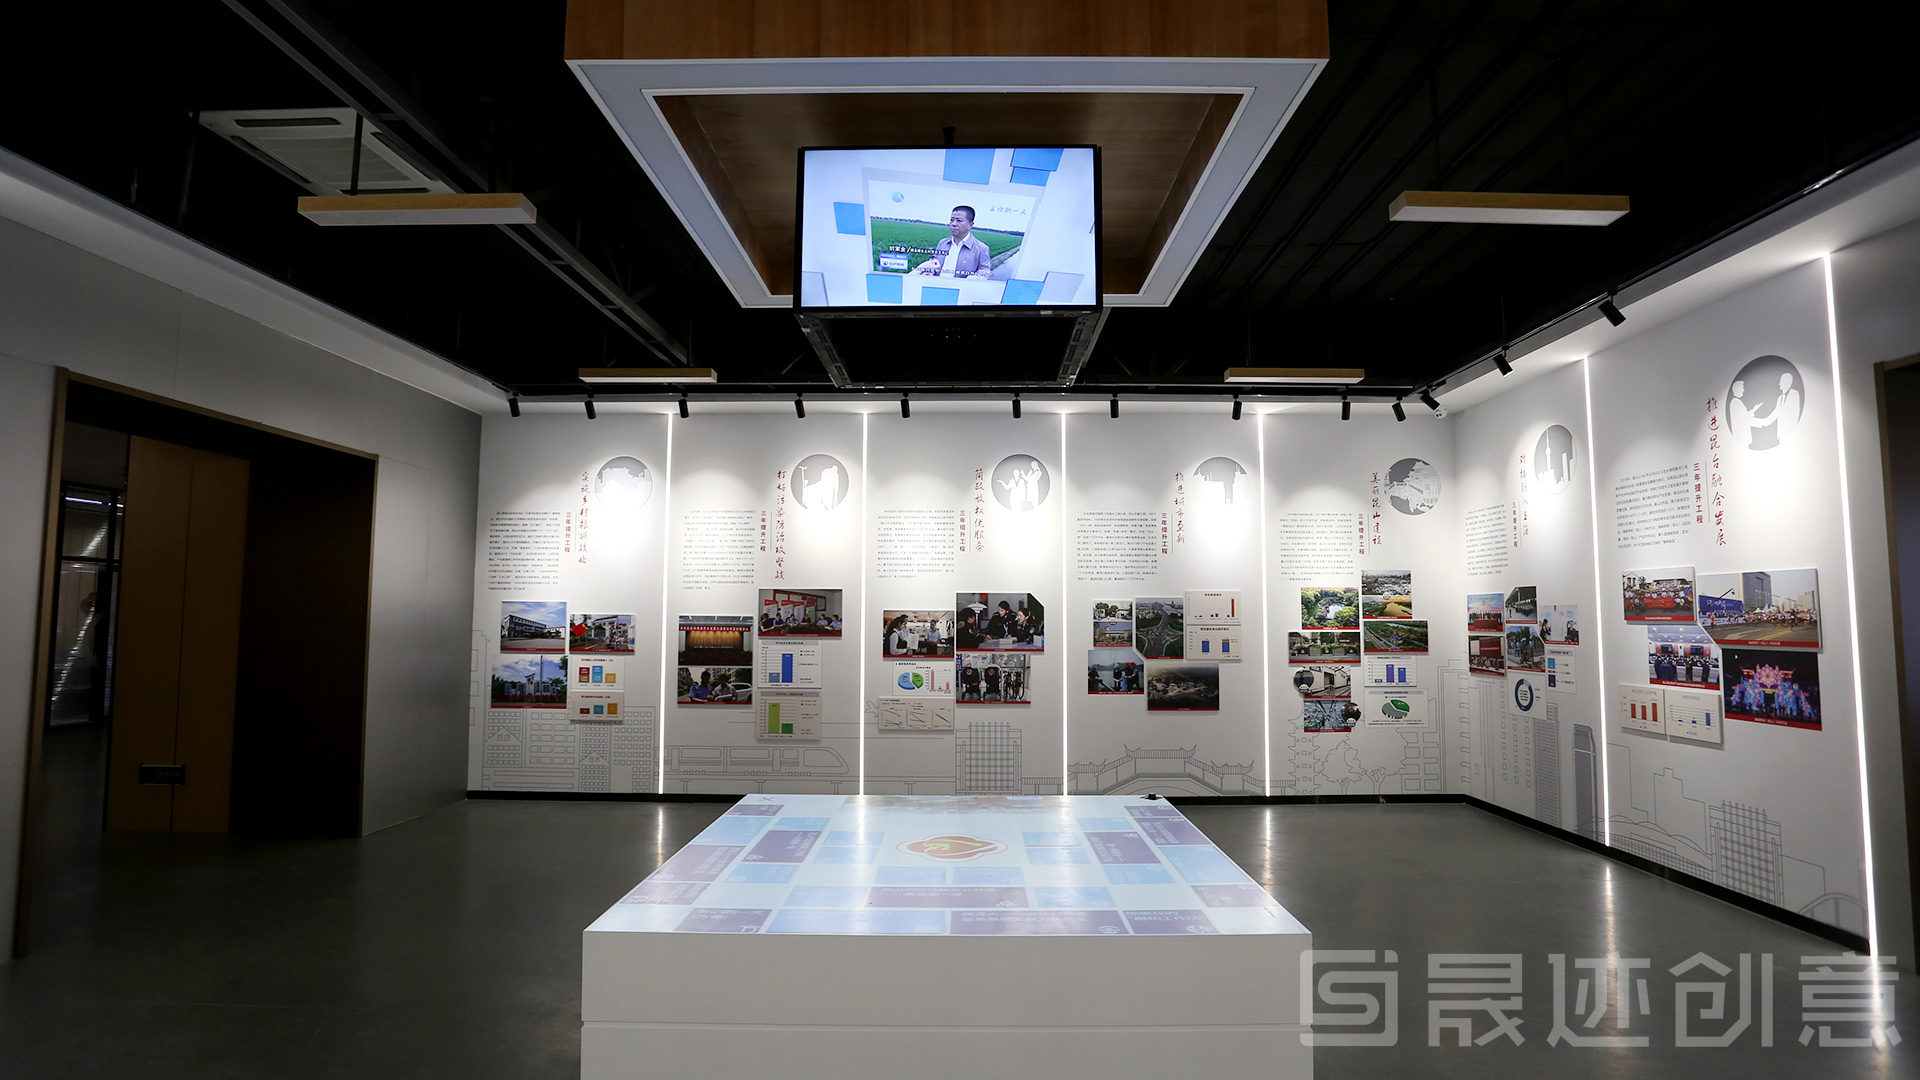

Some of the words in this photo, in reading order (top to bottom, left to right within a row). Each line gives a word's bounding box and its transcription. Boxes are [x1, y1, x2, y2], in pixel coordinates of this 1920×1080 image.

[974, 468, 985, 553] 简政放权优服务
[1174, 472, 1186, 544] 推进城市更新
[1370, 472, 1382, 546] 美丽昆山建设
[1693, 462, 1704, 524] 三年提升工程
[1706, 397, 1727, 546] 推进昆台融合发展
[564, 512, 572, 553] 三年提升工程
[578, 471, 590, 564] 实施乡村振兴战略
[774, 470, 786, 580] 打好污染防治攻坚战
